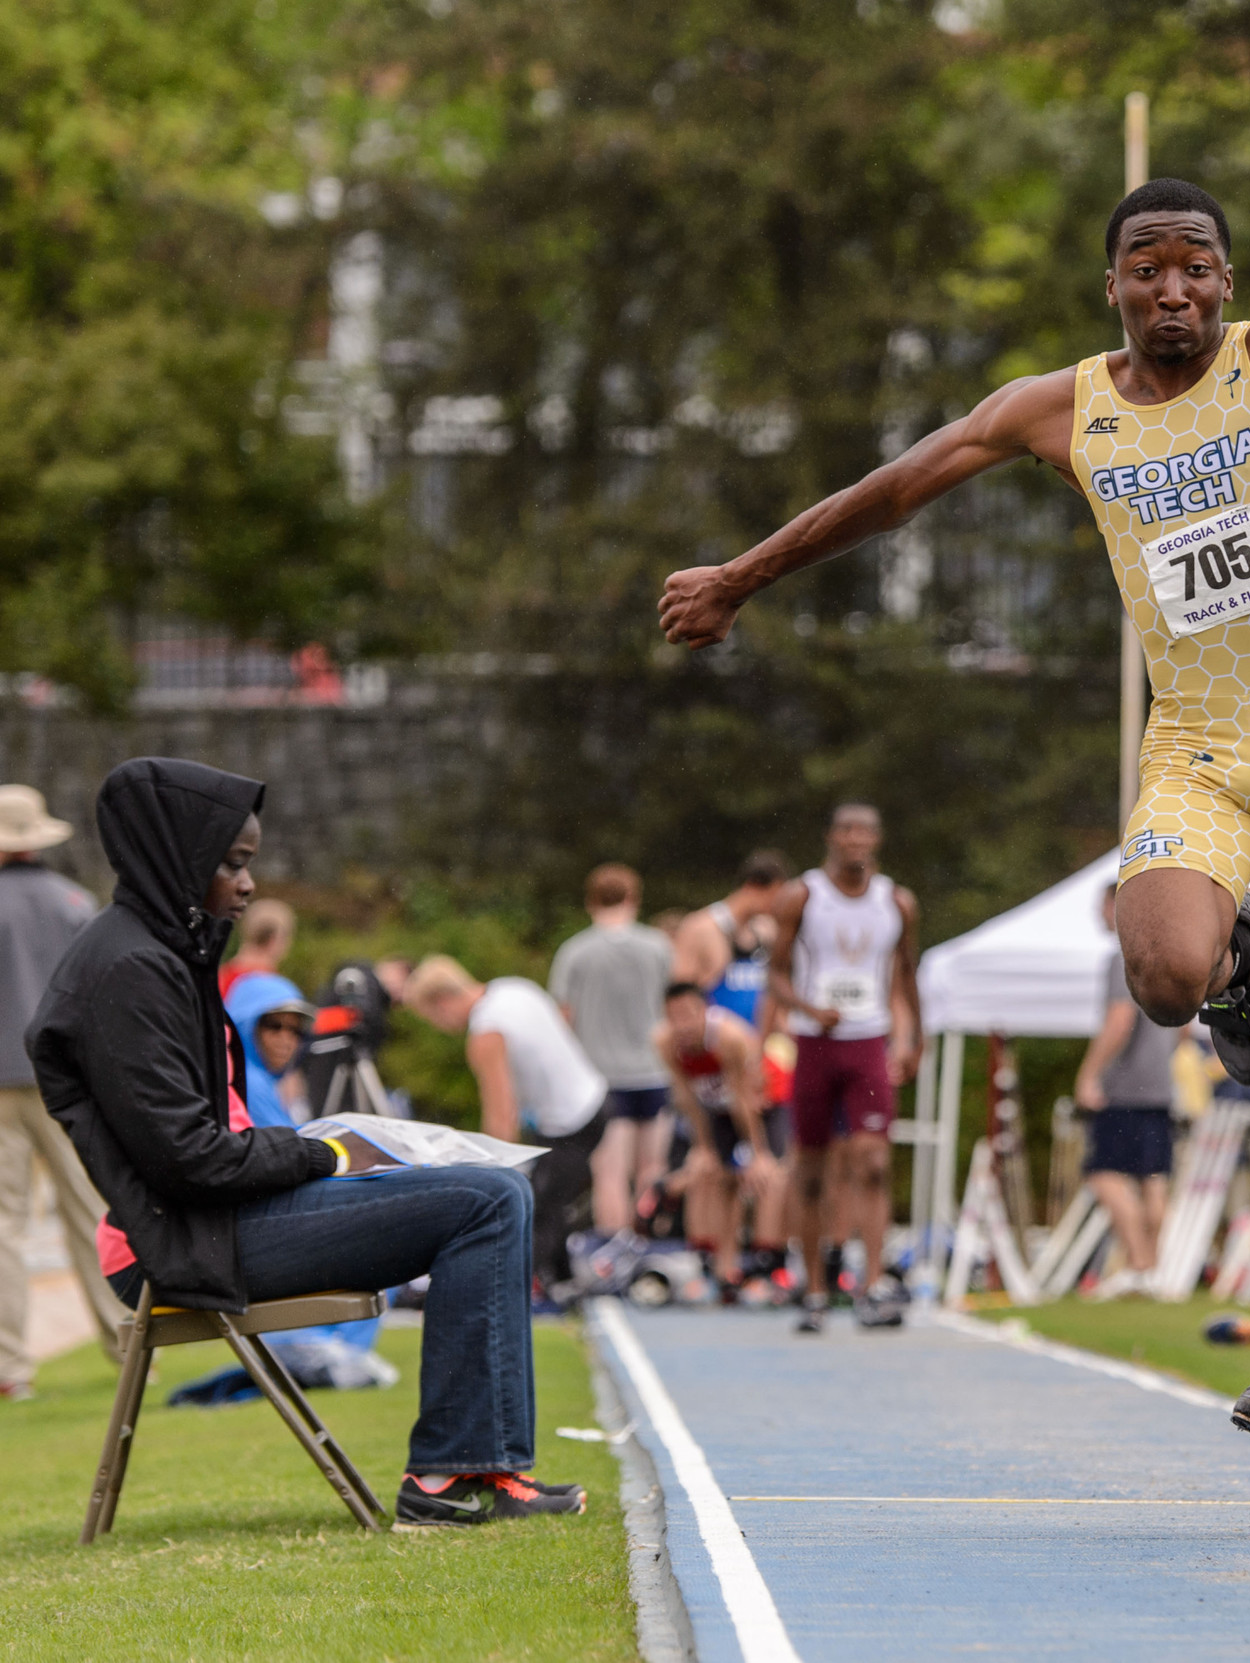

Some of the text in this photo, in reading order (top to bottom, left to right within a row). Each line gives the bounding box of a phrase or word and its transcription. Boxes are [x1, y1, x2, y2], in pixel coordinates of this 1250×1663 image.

[1086, 417, 1120, 431] ACC
[1129, 472, 1238, 525] TECH
[1158, 511, 1250, 555] GEORGIA TECH
[1184, 602, 1227, 625] TRACK
[1228, 597, 1239, 608] &
[1120, 829, 1183, 868] GT
